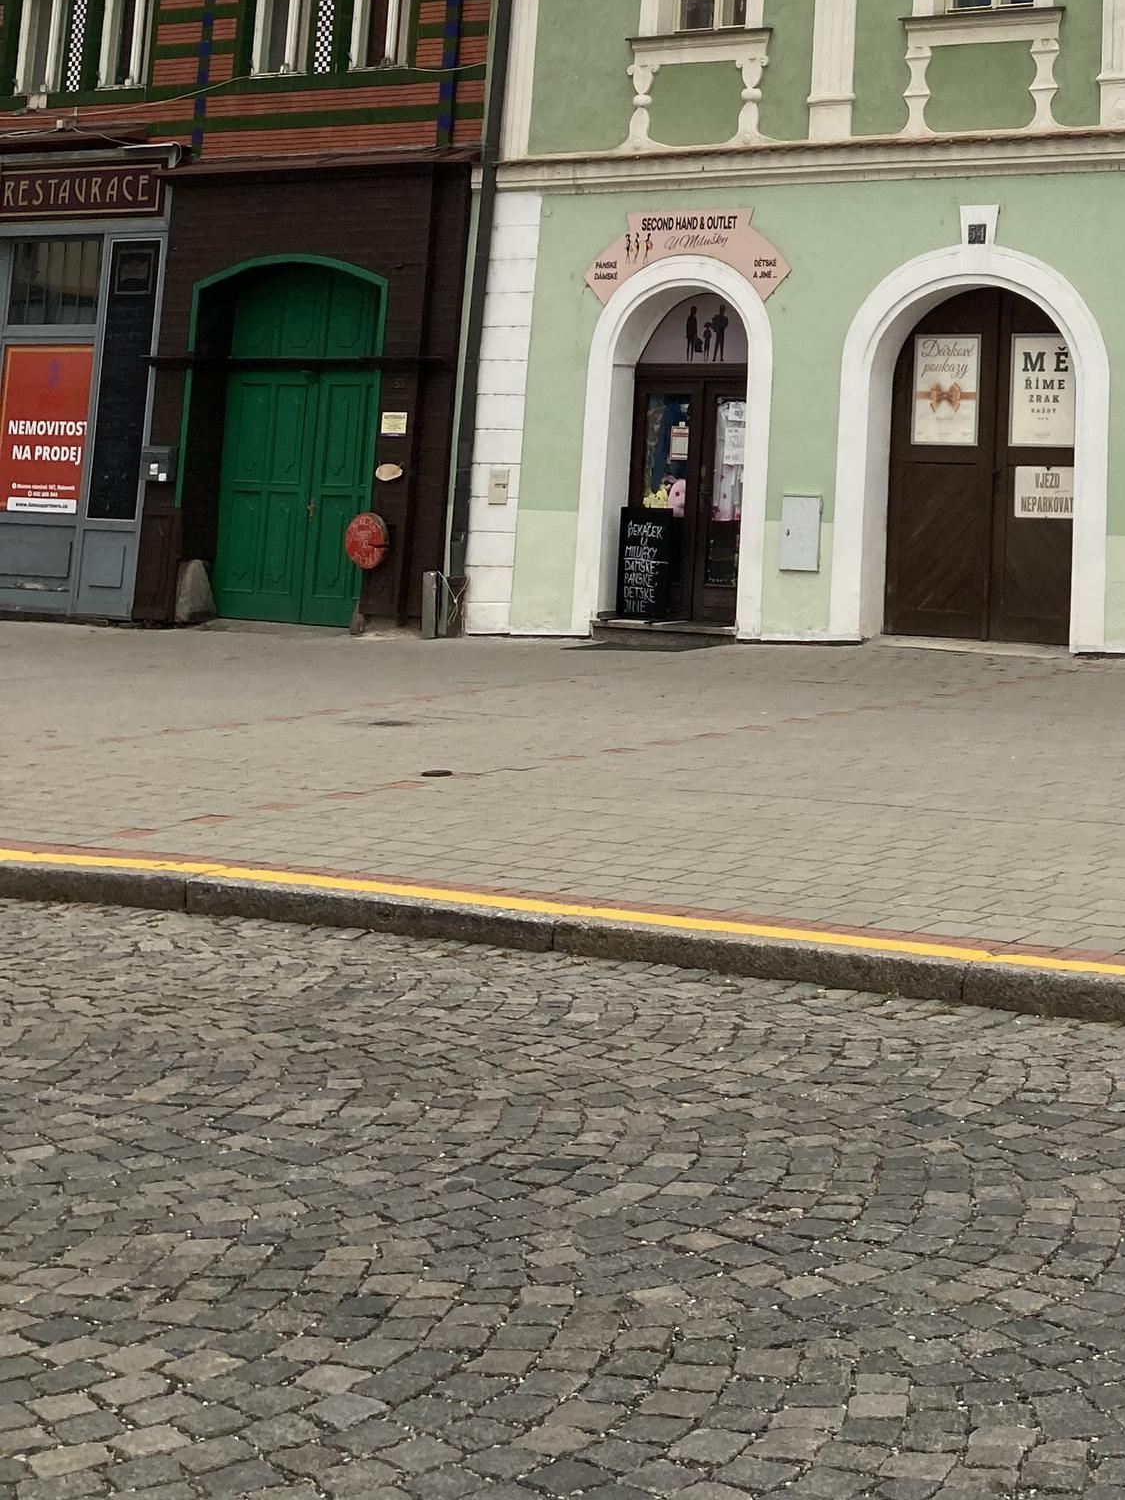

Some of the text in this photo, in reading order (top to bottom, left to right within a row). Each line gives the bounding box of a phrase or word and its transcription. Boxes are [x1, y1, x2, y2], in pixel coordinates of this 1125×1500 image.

[3, 175, 149, 206] RESTAURACE
[641, 215, 738, 231] SECOND HAND & OUTLET
[679, 233, 729, 250] Milušky
[921, 358, 969, 379] poukazy
[1024, 377, 1066, 390] ŘÍME
[1028, 394, 1060, 403] ZRAK
[12, 445, 82, 466] NA PRODEJ
[1035, 472, 1060, 489] VJEZD
[1020, 496, 1073, 513] NEPARKOVAT
